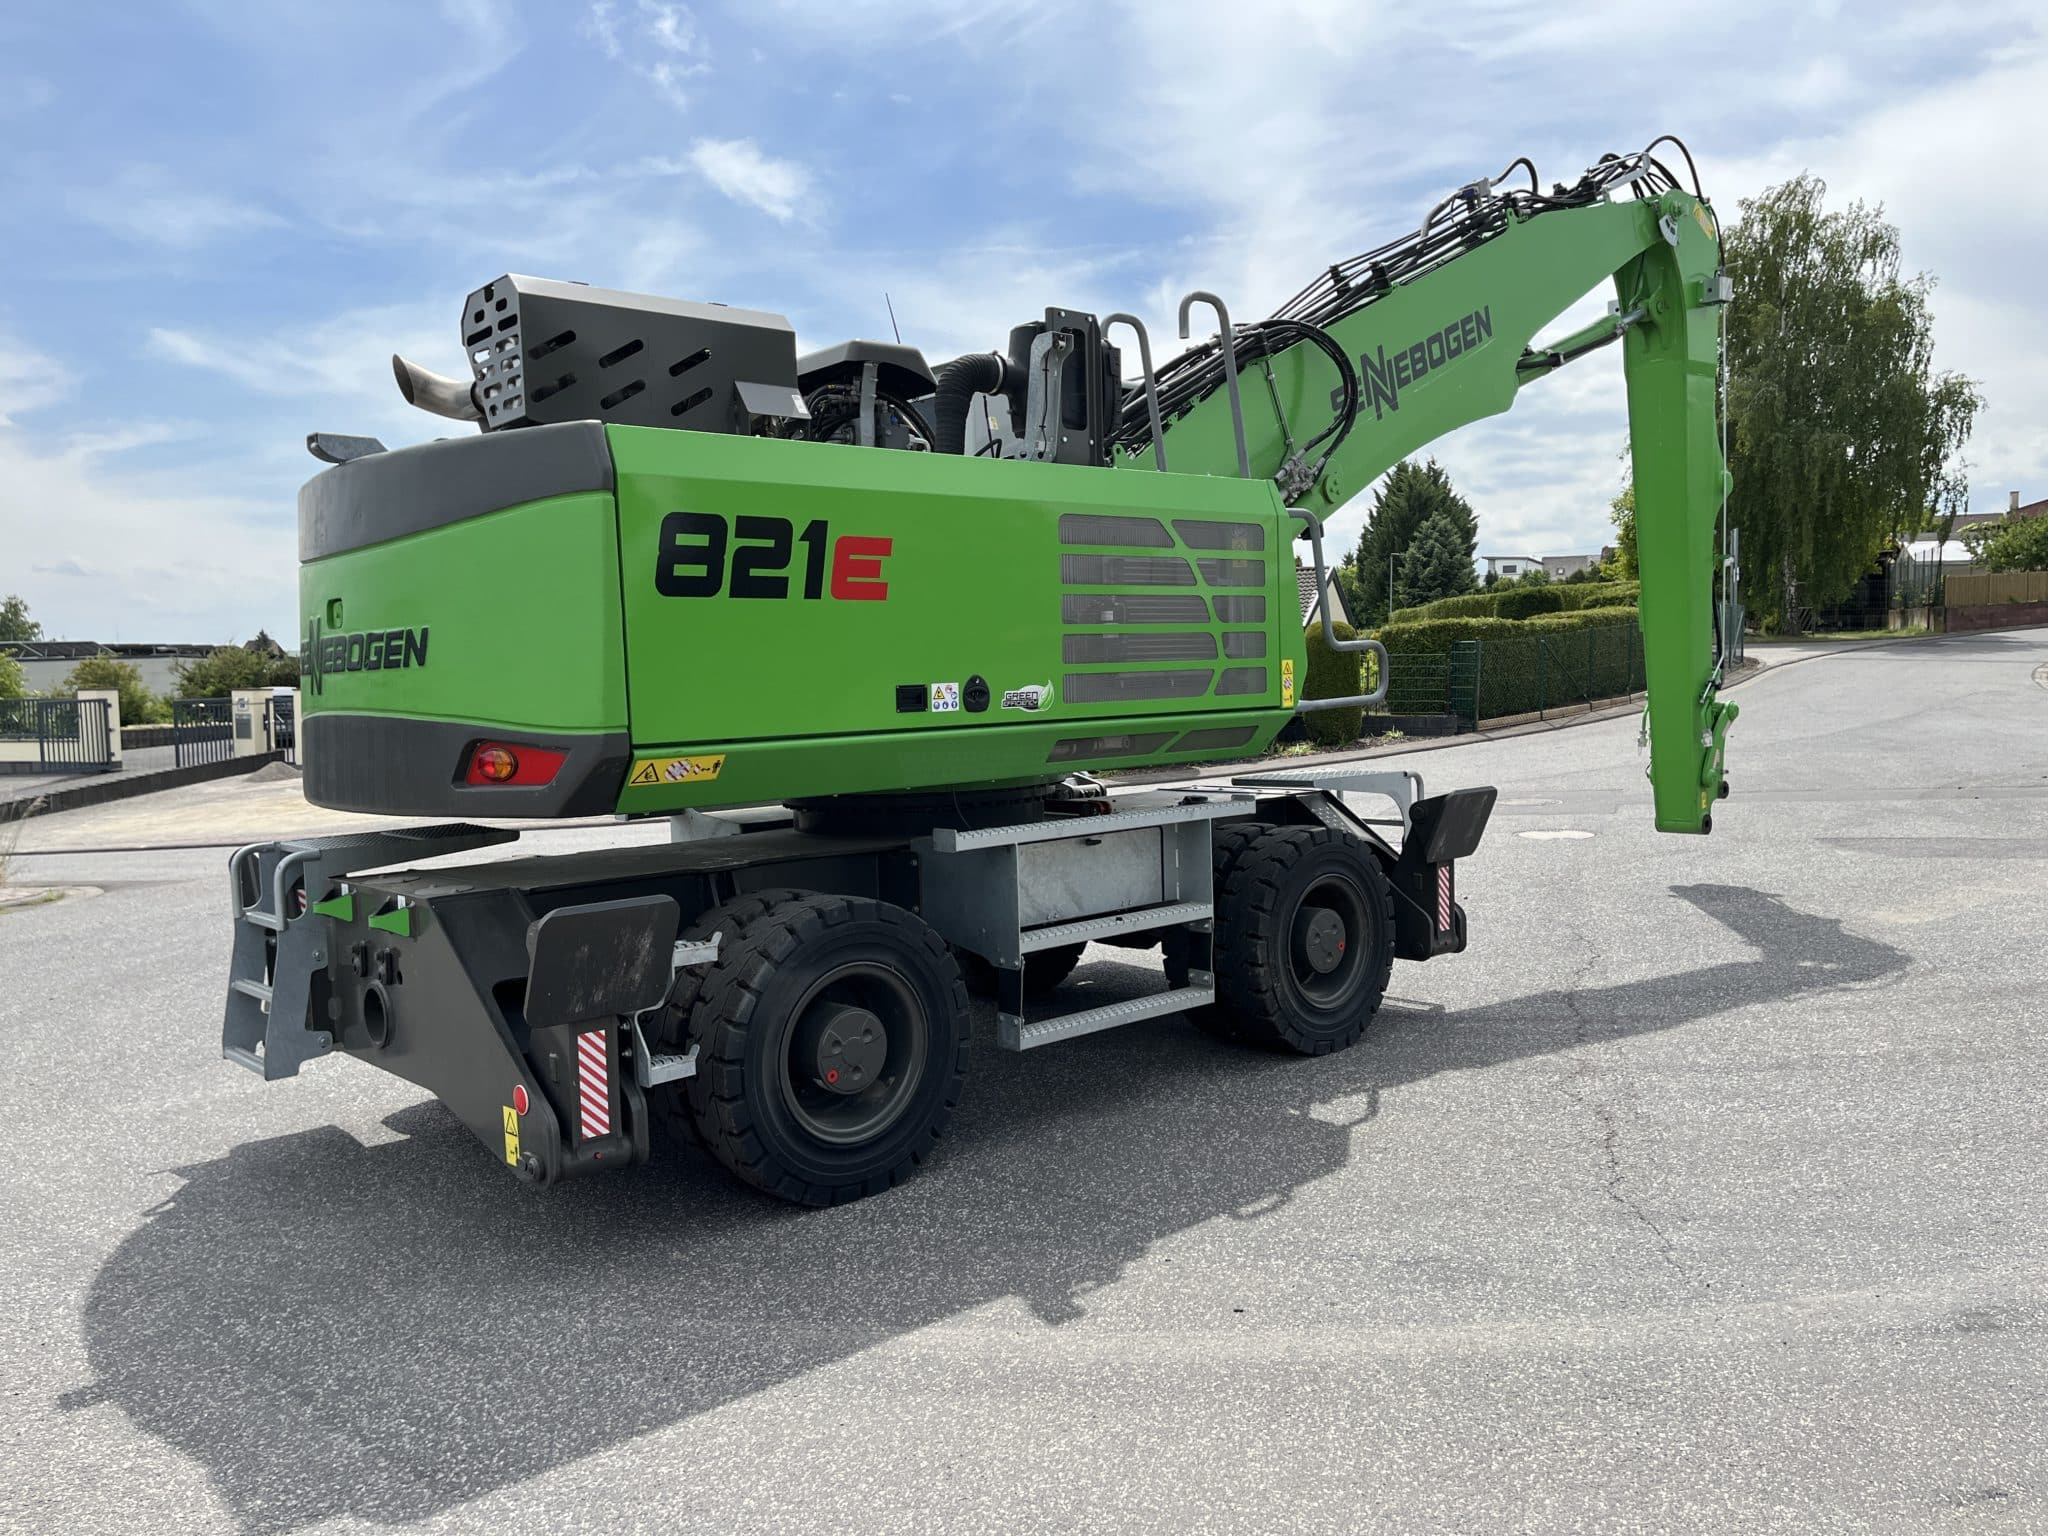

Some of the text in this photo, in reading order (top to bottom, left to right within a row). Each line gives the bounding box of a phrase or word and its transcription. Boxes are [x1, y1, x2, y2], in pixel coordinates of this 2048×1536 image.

[654, 511, 894, 601] 821E
[300, 616, 429, 696] ENNEBOGEN
[1005, 691, 1039, 701] GREEN
